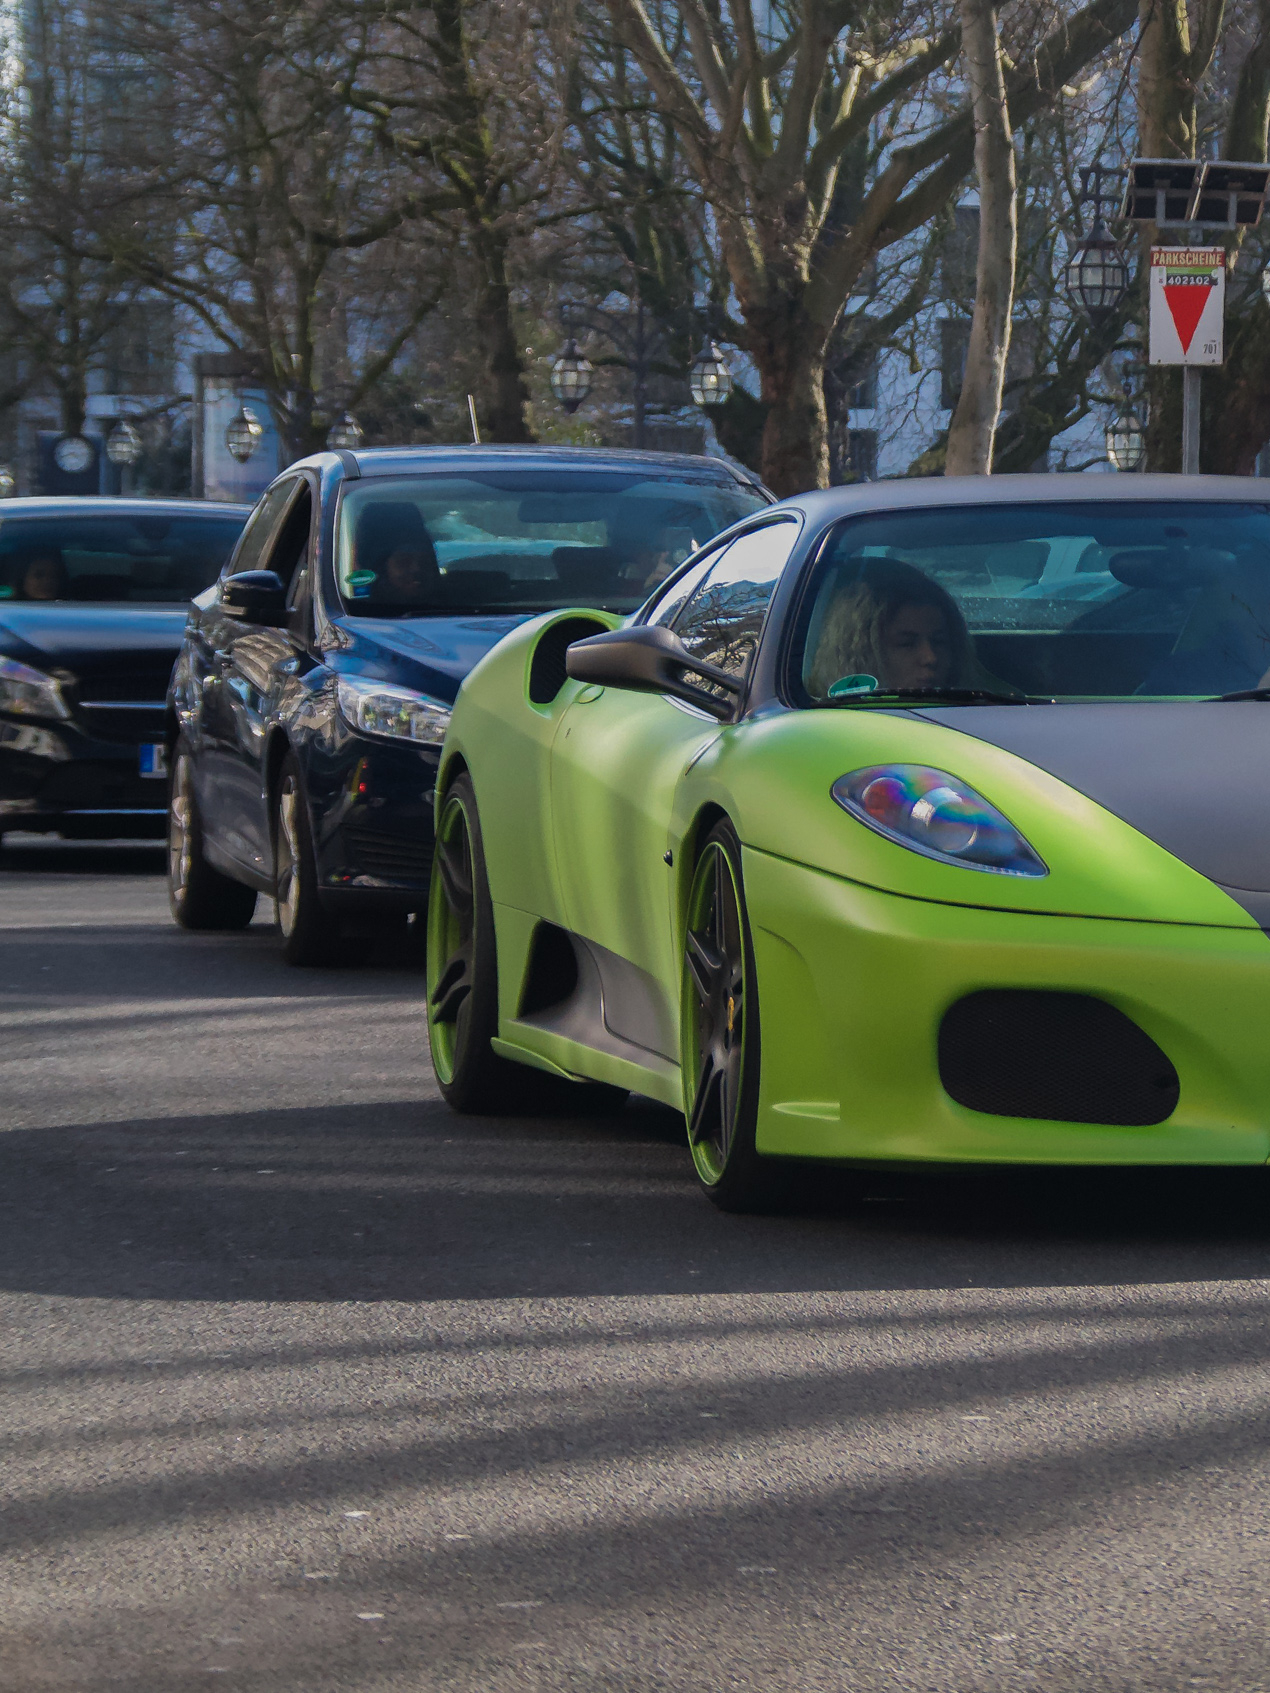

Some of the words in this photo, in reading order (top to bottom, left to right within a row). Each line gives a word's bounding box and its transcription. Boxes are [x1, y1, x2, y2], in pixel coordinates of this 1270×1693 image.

[1152, 252, 1223, 265] PARKSCHEINE
[1167, 275, 1210, 285] 402102
[1203, 343, 1217, 355] 701
